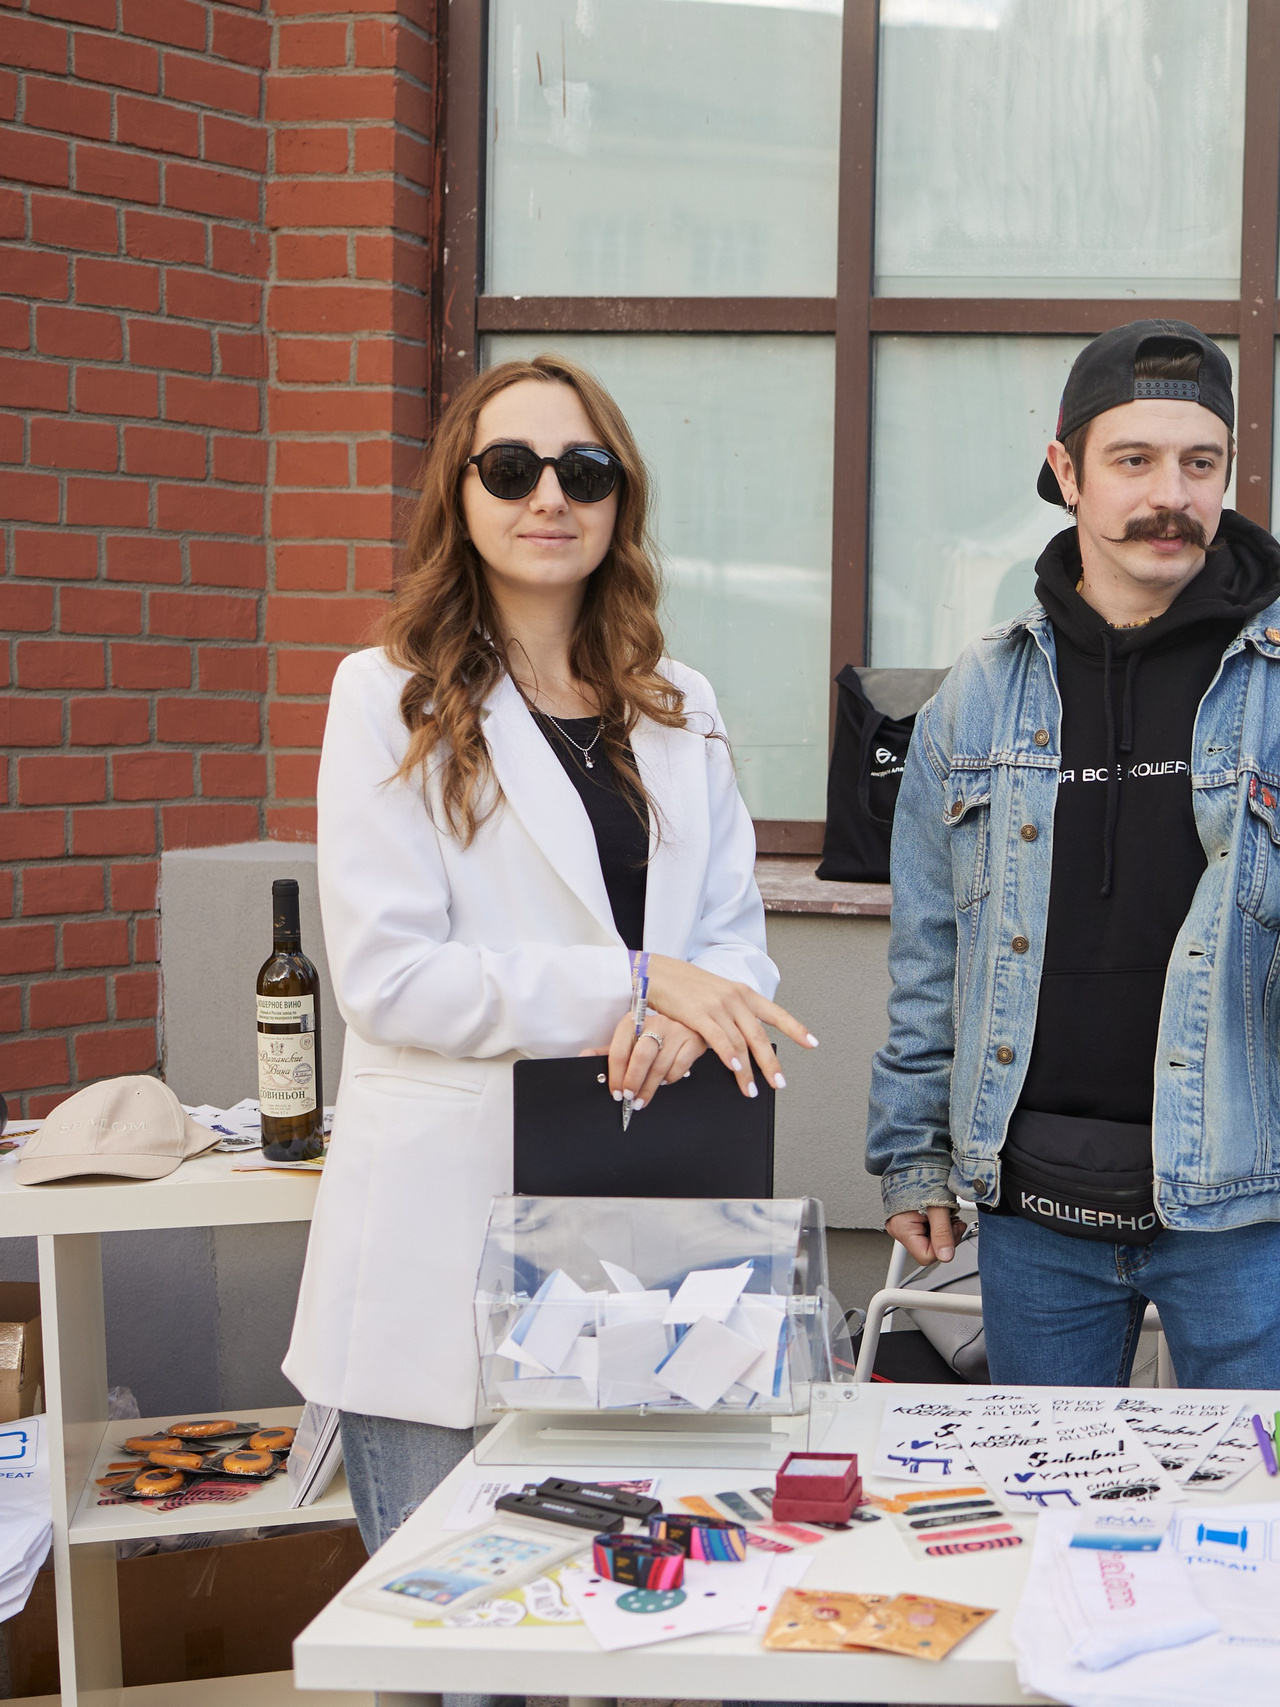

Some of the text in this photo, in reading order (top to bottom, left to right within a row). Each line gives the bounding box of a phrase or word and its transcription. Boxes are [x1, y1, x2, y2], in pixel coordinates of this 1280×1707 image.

[1128, 760, 1190, 779] КОШЕР
[284, 1000, 302, 1009] ВИНО
[59, 1118, 148, 1135] SHALOM
[1020, 1191, 1157, 1231] КОШЕРНО
[893, 1406, 973, 1418] KOSHER
[981, 1408, 1042, 1417] ALL DAY
[970, 1436, 1048, 1448] KOSHER
[1059, 1428, 1116, 1442] ALL DAY
[1038, 1463, 1141, 1481] YAHAD
[1184, 1555, 1258, 1573] TORAH
